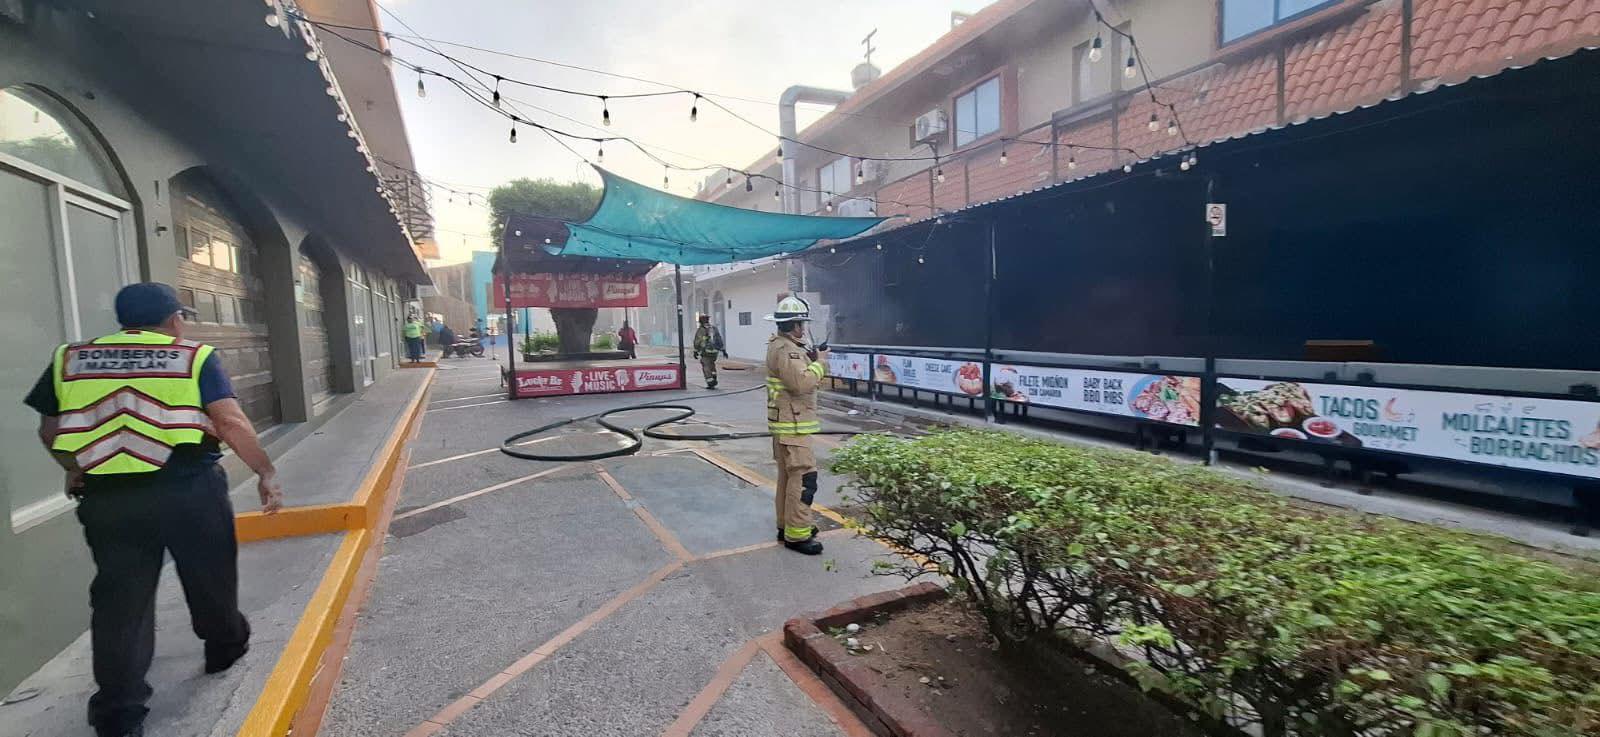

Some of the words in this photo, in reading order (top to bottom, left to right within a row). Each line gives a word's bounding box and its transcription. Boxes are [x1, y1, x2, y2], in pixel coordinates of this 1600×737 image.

[79, 350, 180, 360] BOMBEROS
[589, 371, 610, 381] LIVE
[1019, 375, 1039, 387] FILETE
[585, 380, 616, 392] MUSIC
[1083, 377, 1101, 389] BABY
[1103, 378, 1123, 390] BACK
[1083, 389, 1101, 403] BBQ
[1103, 390, 1124, 405] RIBS
[1319, 395, 1379, 420] TACOS
[1353, 422, 1419, 442] GOURMET
[1441, 412, 1571, 439] MOLCAJETES
[1470, 436, 1598, 466] BORRACHOS
